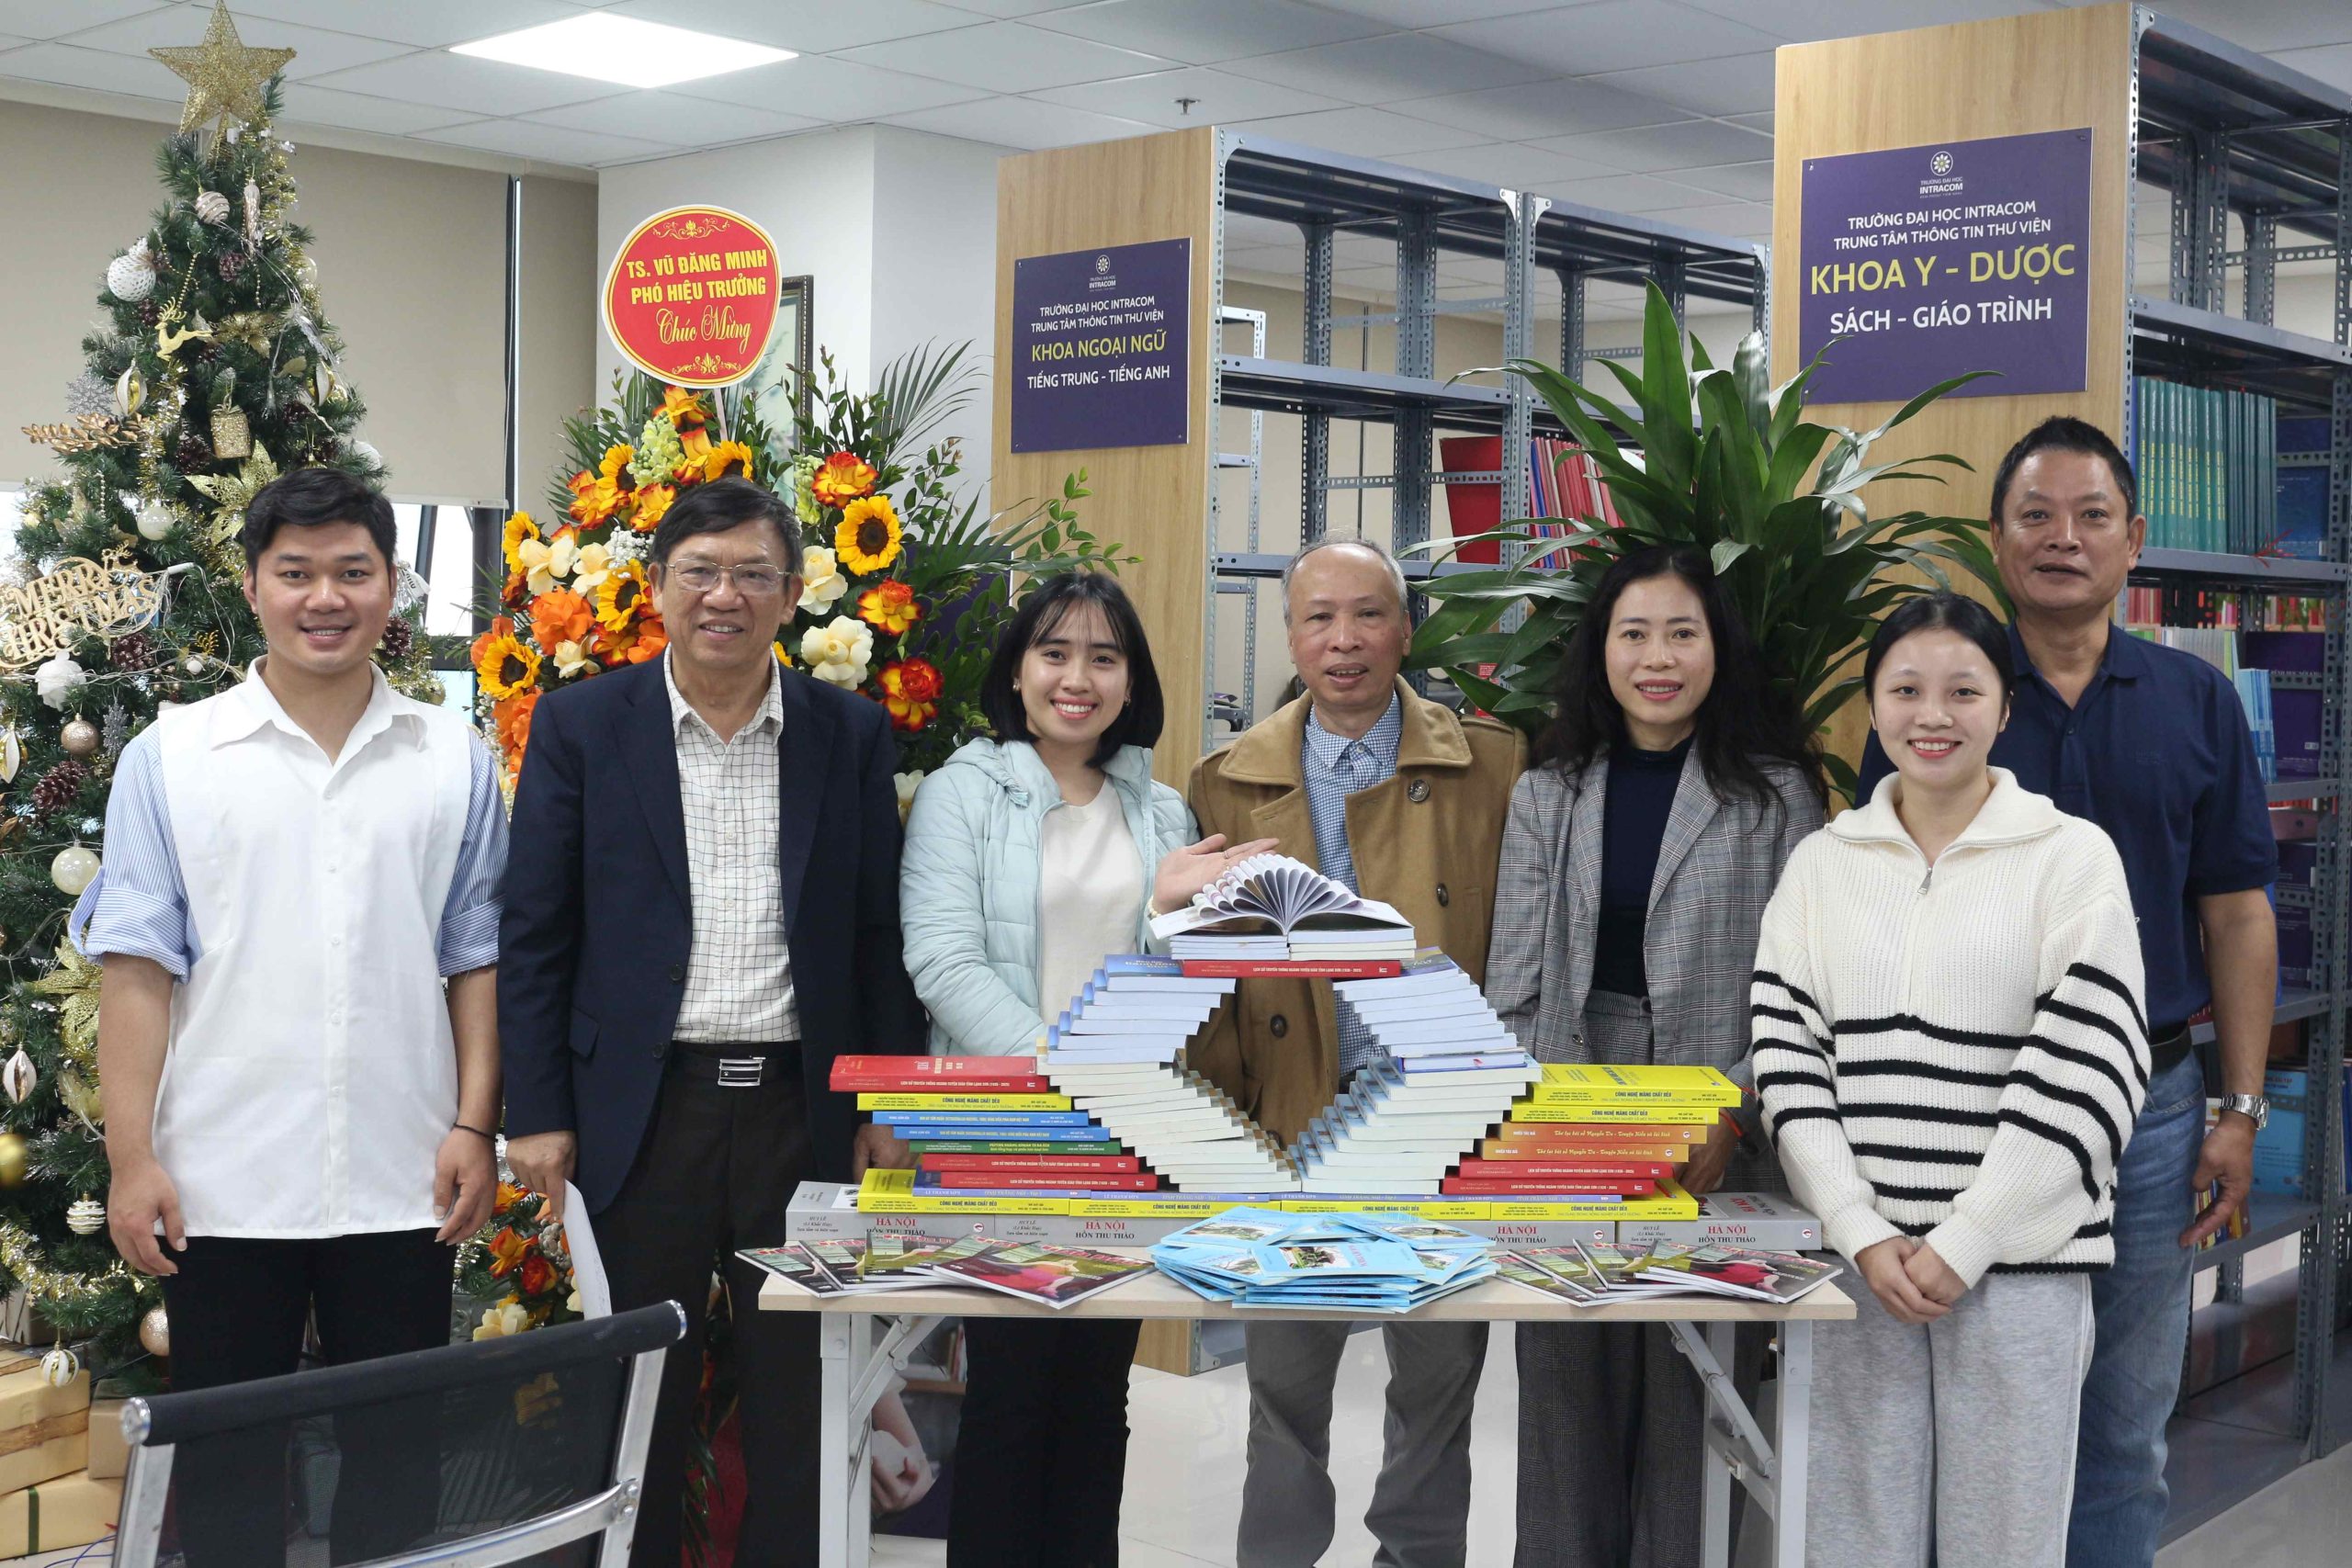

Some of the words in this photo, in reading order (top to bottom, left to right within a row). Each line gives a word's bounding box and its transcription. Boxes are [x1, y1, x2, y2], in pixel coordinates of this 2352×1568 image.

[1920, 183, 1962, 194] INTRACOM
[1849, 212, 1903, 230] TRƯỜNG
[1905, 211, 1928, 226] ĐẠI
[1932, 208, 1962, 224] HỌC
[1964, 200, 2036, 219] INTRACOM
[1834, 235, 1878, 251] TRUNG
[1881, 230, 1907, 246] TÂM
[1911, 225, 1959, 244] THÔNG
[1962, 225, 1984, 239] TIN
[1986, 220, 2018, 235] THƯ
[2019, 217, 2052, 235] VIỆN
[627, 261, 650, 279] TS.
[653, 254, 674, 276] VŨ
[678, 252, 721, 274] ĐĂNG
[726, 250, 767, 270] MINH
[1811, 259, 1905, 295] KHOA
[1914, 255, 1937, 287] Y
[1970, 243, 2075, 285] DƯỢC
[631, 283, 663, 304] PHÓ
[667, 279, 703, 304] HIỆU
[707, 273, 766, 299] TRƯỞNG
[1090, 280, 1115, 288] INTRACOM
[1040, 303, 1073, 317] TRƯỜNG
[1075, 301, 1090, 316] ĐẠI
[1091, 299, 1110, 313] HỌC
[1111, 296, 1155, 309] INTRACOM
[1830, 307, 1891, 334] SÁCH
[1913, 299, 1971, 329] GIÁO
[1977, 295, 2052, 323] TRÌNH
[656, 308, 697, 345] Chúc
[701, 305, 752, 355] Mừng
[1031, 321, 1058, 333] TRUNG
[1060, 318, 1077, 330] TÂM
[1079, 316, 1107, 329] THÔNG
[1110, 315, 1123, 325] TIN
[1125, 312, 1143, 323] THƯ
[1144, 310, 1164, 323] VIỆN
[1032, 342, 1074, 362] KHOA
[1079, 336, 1126, 358] NGOẠI
[1130, 329, 1167, 353] NGỮ
[1027, 370, 1058, 389] TIẾNG
[1061, 371, 1099, 387] TRUNG
[1108, 364, 1142, 383] TIẾNG
[1145, 366, 1170, 380] ANH
[6, 562, 112, 618] MERRY
[876, 1216, 891, 1226] HÀ
[895, 1216, 917, 1229] NỘI
[1086, 1220, 1101, 1230] HÀ
[1104, 1220, 1125, 1231] NỘI
[1498, 1224, 1513, 1234] HÀ
[1517, 1224, 1536, 1236] NỘI
[1708, 1224, 1723, 1234] HÀ
[1727, 1224, 1747, 1235] NỘI
